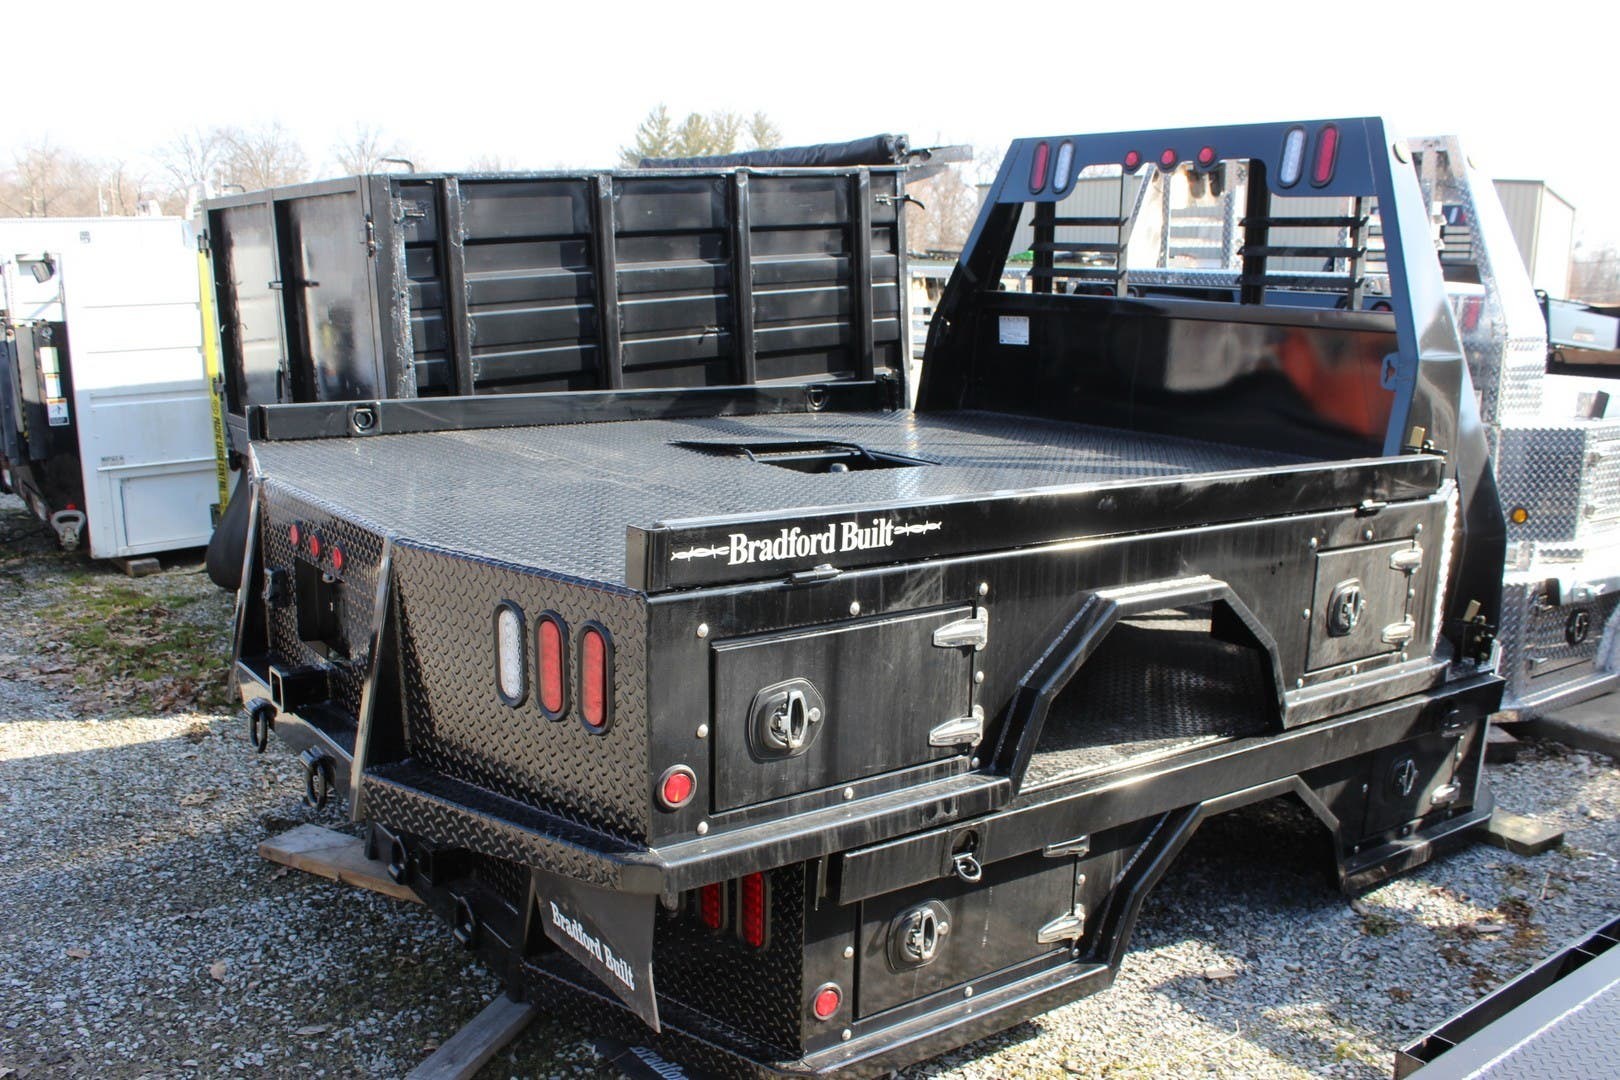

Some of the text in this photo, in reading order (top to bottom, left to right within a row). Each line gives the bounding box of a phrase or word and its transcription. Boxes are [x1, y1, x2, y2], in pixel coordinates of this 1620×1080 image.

[728, 518, 894, 565] Bradford Built
[550, 900, 635, 991] Bradford Built
